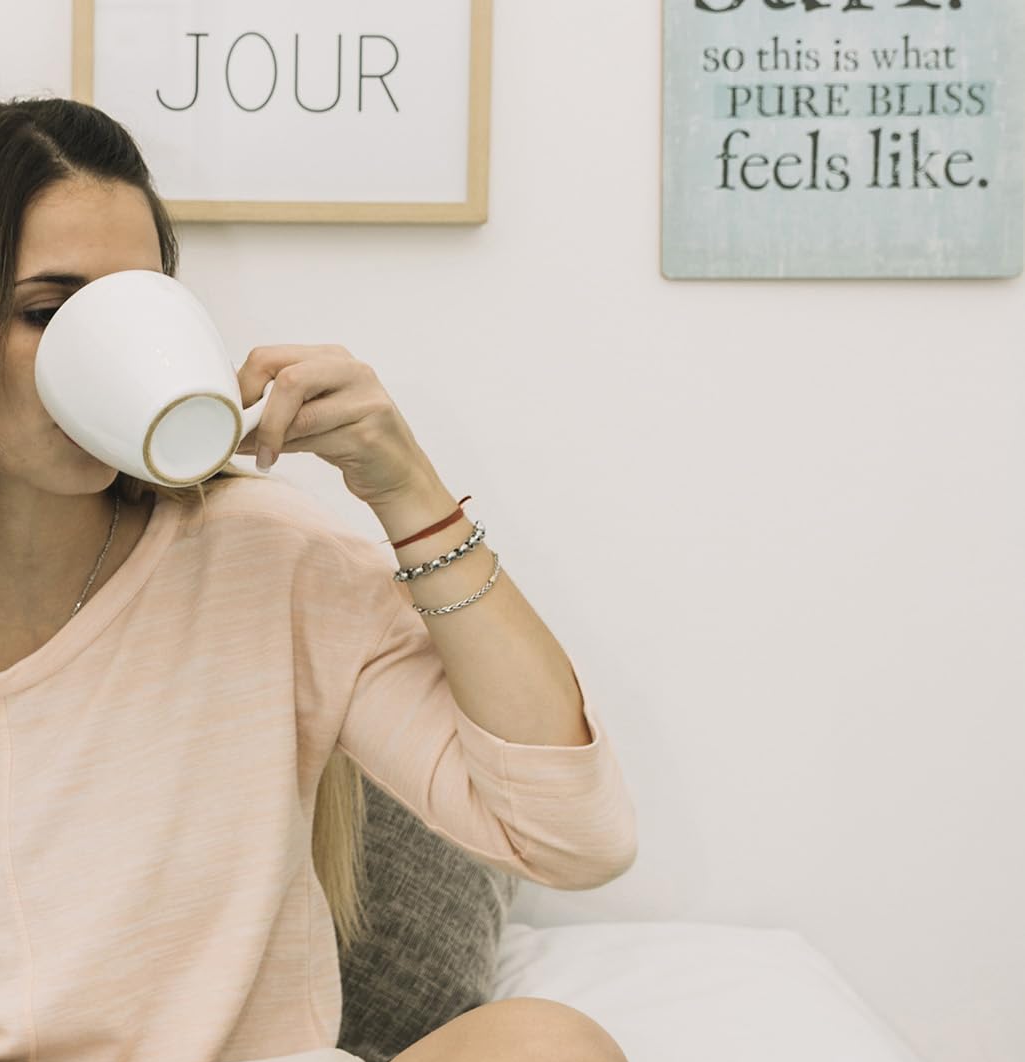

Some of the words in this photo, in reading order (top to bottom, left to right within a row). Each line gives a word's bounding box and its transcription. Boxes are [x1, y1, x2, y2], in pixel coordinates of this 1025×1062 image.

[156, 31, 401, 114] JOUR
[702, 46, 745, 73] so
[757, 35, 821, 71] this
[833, 38, 859, 71] is
[872, 35, 956, 70] what
[726, 84, 851, 119] PURE
[868, 81, 987, 117] BLISS
[715, 128, 851, 192] feels
[867, 127, 989, 190] like.
